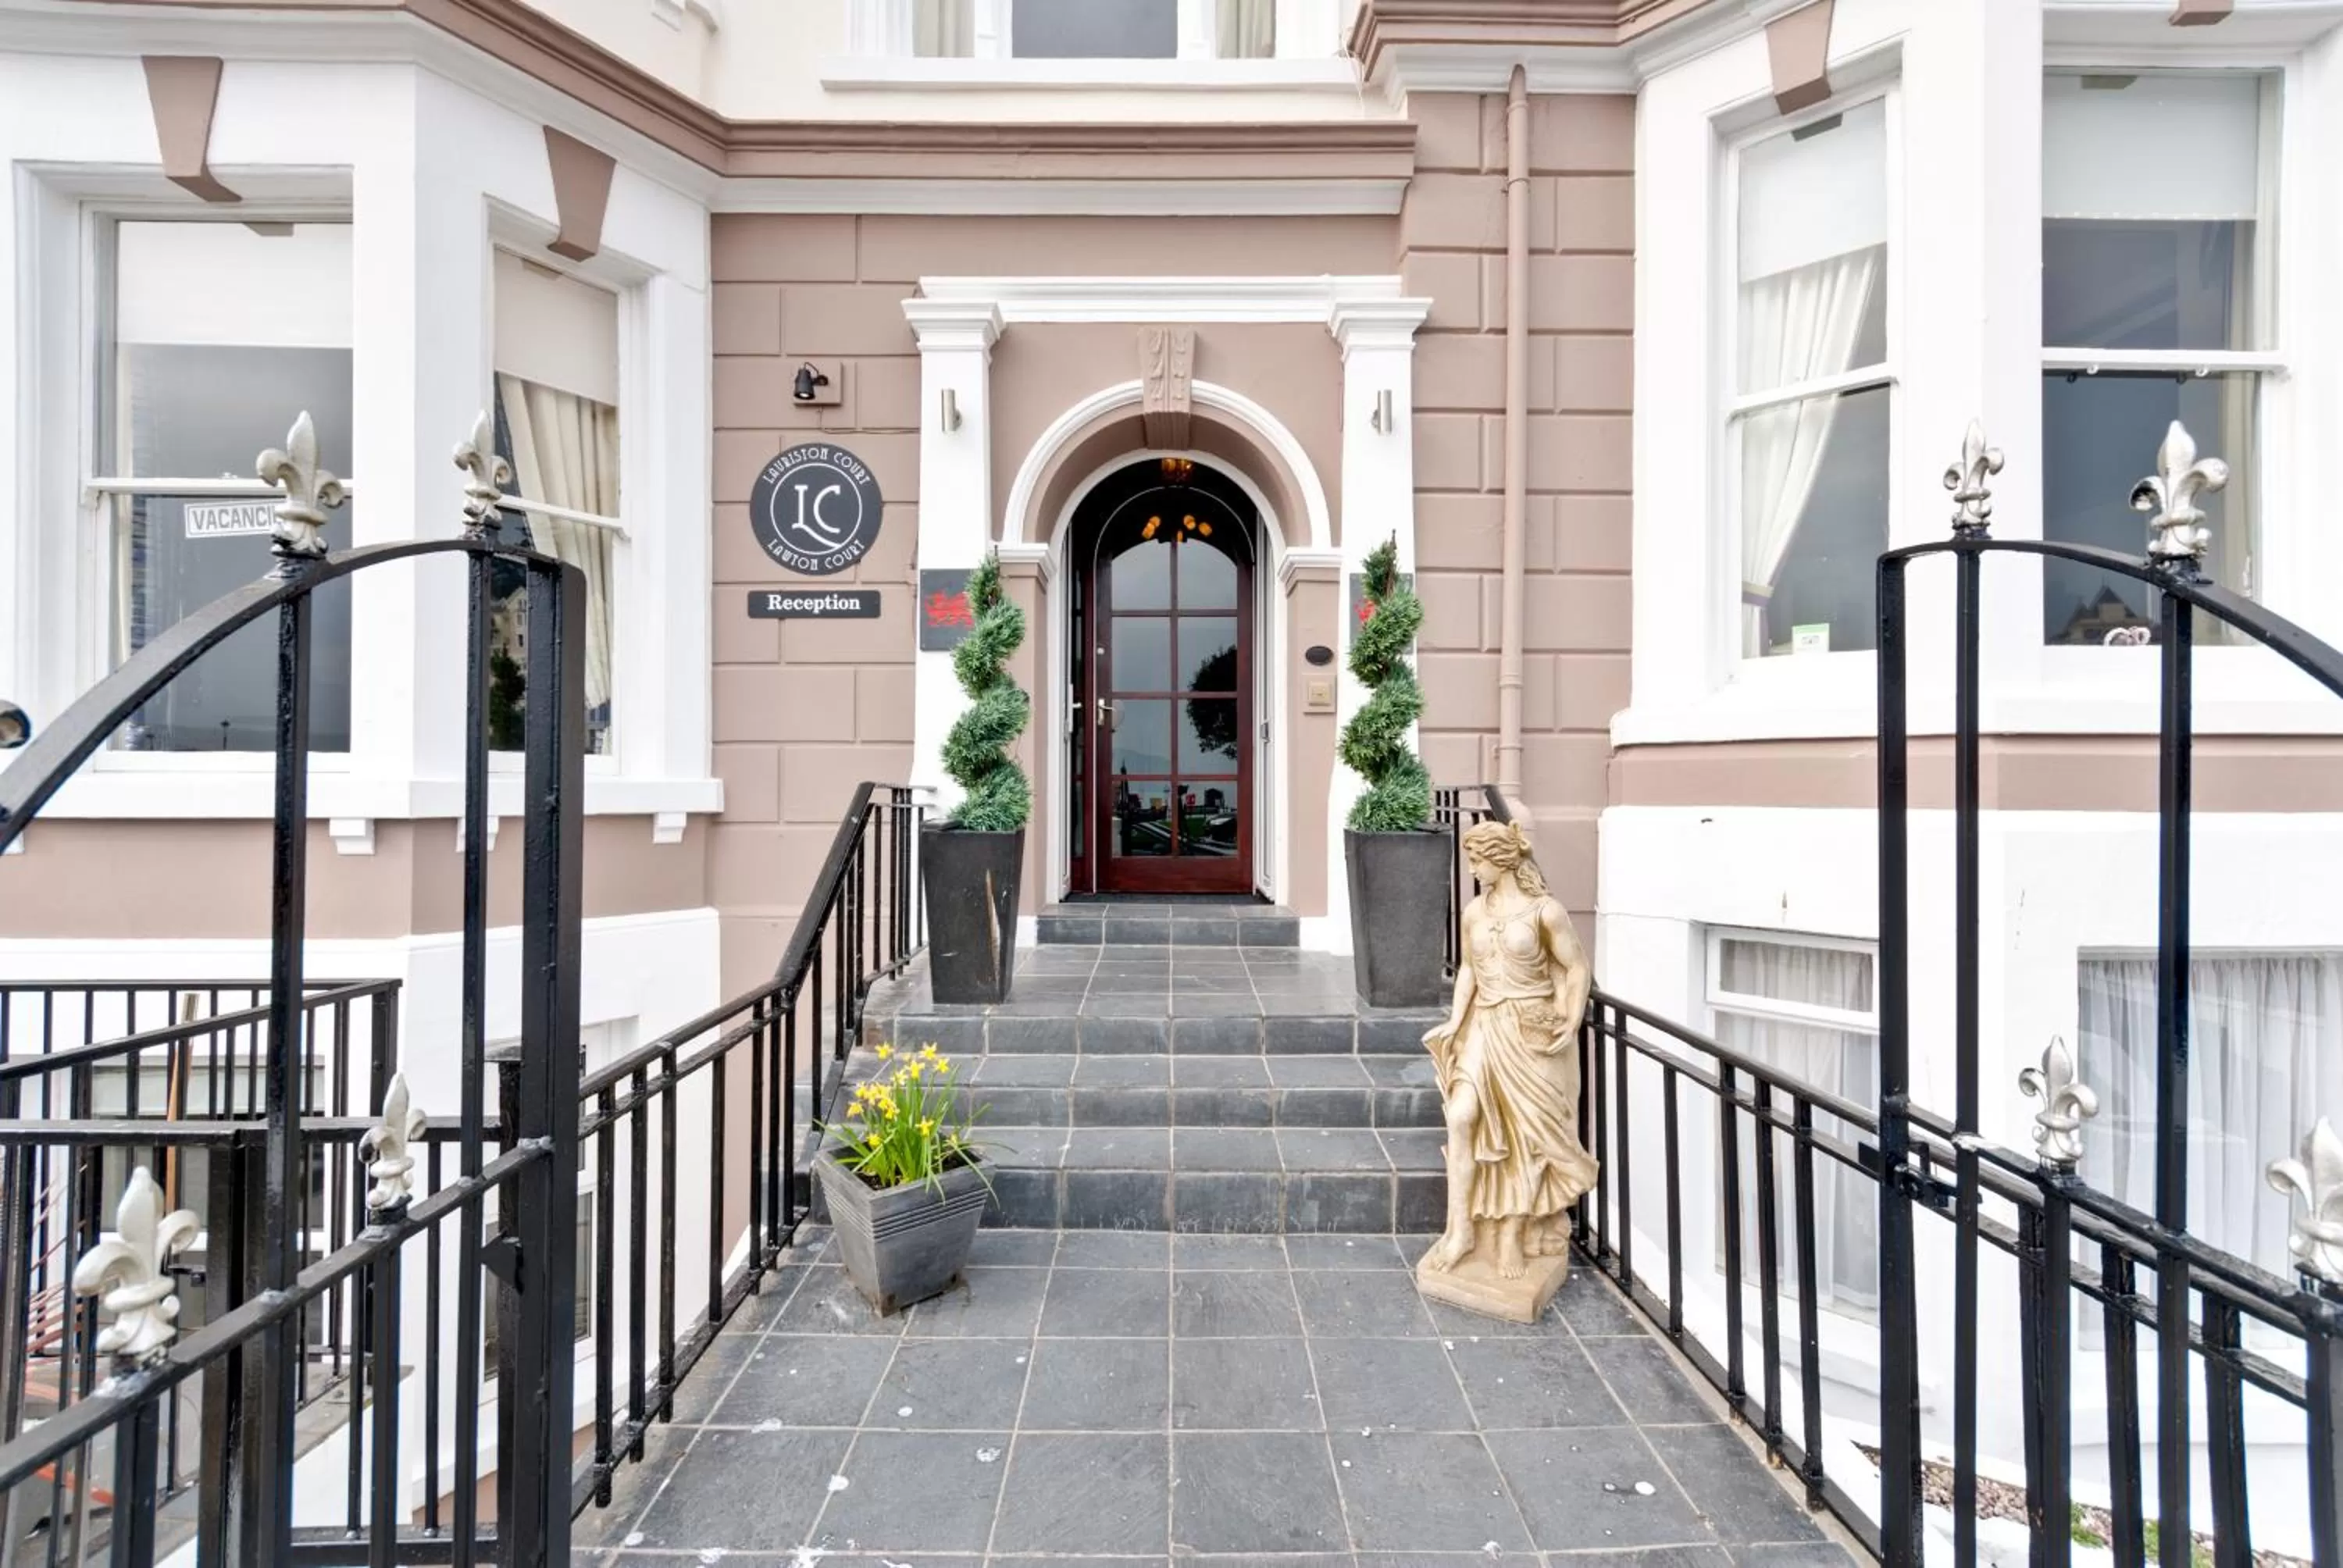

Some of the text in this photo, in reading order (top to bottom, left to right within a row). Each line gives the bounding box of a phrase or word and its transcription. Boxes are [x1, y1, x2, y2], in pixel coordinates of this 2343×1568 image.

[763, 447, 871, 485] LAURISTON COURT
[192, 506, 275, 529] VACANCI
[767, 539, 865, 571] LAWTON COURT
[767, 594, 861, 614] Reception
